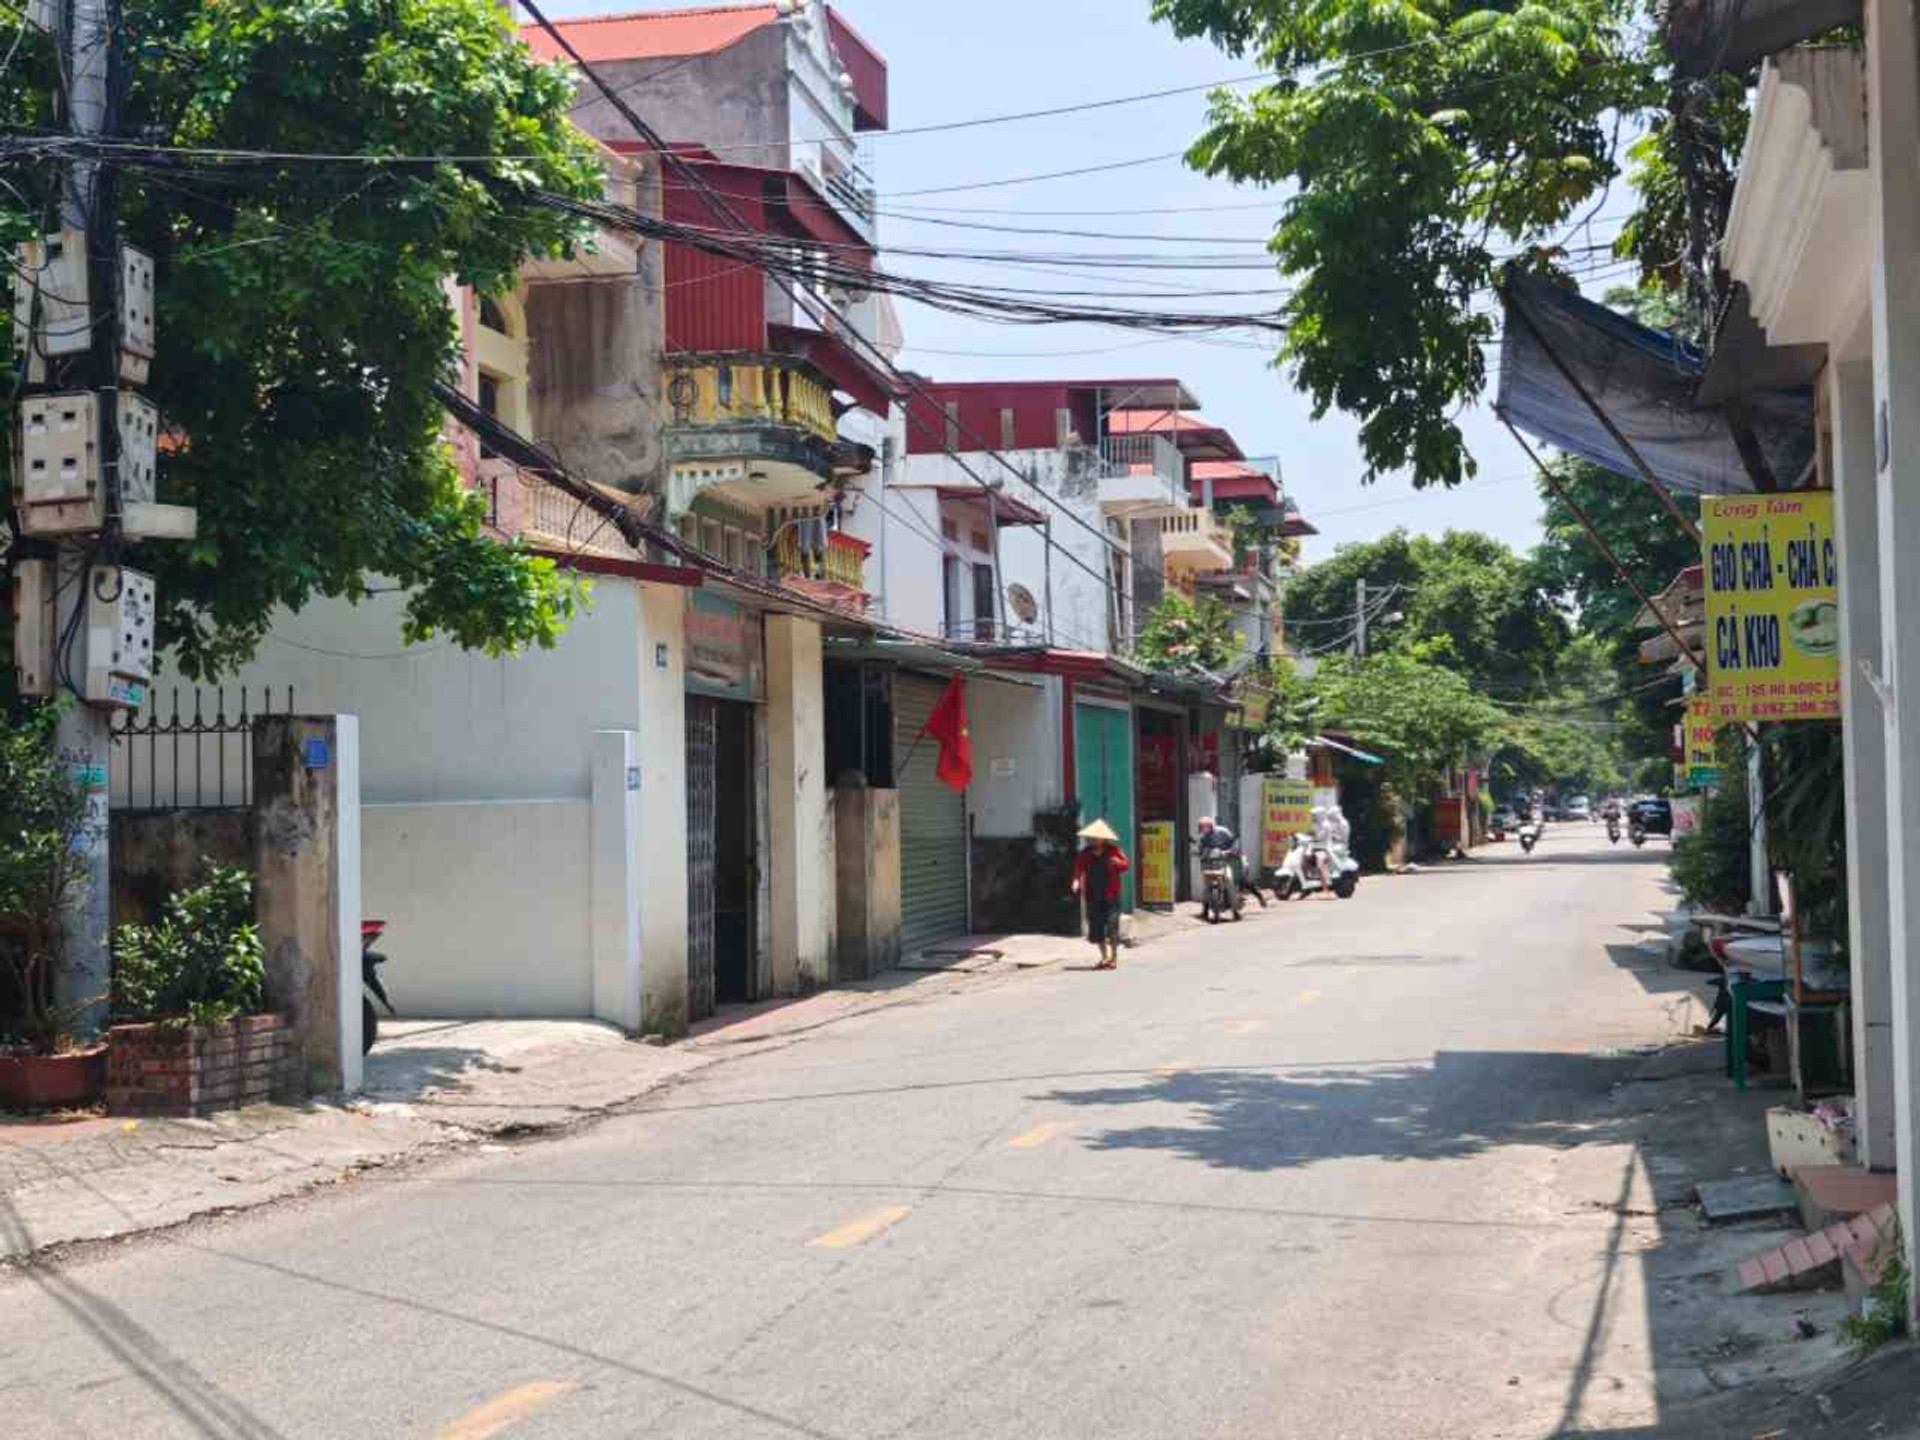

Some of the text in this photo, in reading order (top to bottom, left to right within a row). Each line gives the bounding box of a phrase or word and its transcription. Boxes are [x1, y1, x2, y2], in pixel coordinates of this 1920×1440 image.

[1741, 522, 1774, 591] CHẢ
[1788, 521, 1820, 589] CHẢ
[1823, 537, 1837, 588] C
[1744, 613, 1780, 669] KHO
